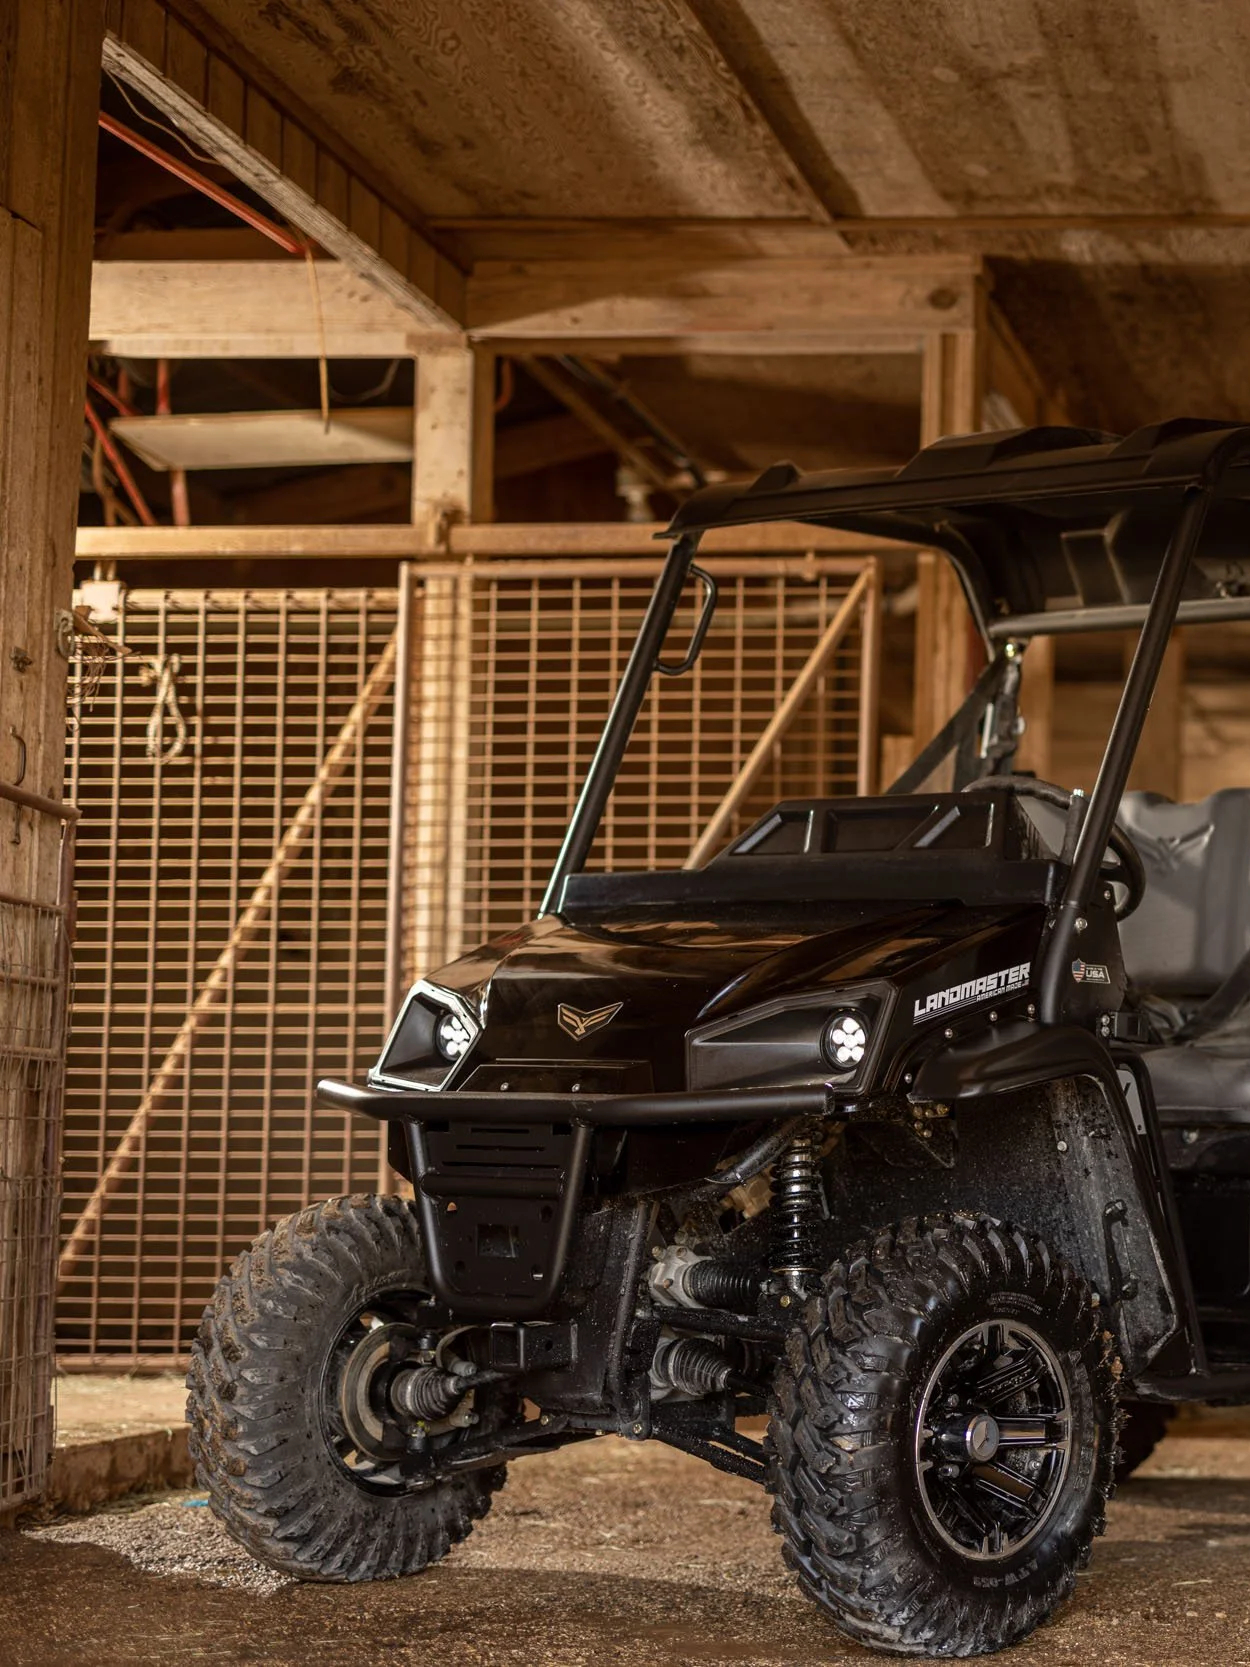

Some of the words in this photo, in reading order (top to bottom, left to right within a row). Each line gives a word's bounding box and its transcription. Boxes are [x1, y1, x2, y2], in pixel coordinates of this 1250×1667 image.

[1085, 968, 1105, 979] USA
[914, 962, 1031, 1018] LANDMASTER
[976, 986, 1006, 1002] AMERICAN
[1005, 980, 1022, 993] MADE
